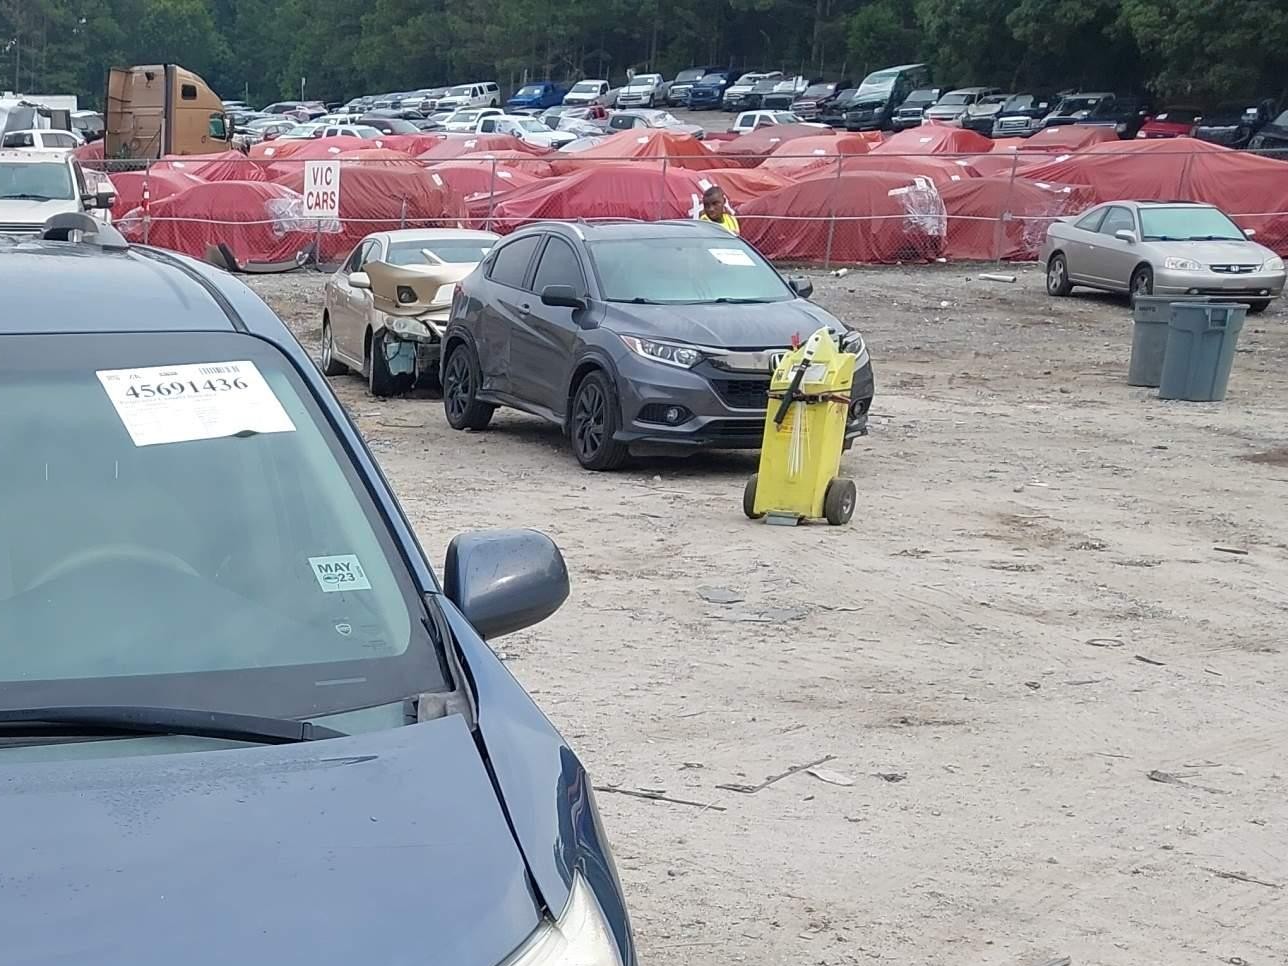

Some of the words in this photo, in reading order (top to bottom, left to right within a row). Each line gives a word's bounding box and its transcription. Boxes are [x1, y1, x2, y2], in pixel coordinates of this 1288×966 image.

[312, 167, 333, 186] VIC
[306, 191, 336, 210] CARS
[125, 376, 249, 399] 45691436
[317, 562, 351, 573] MAY
[337, 573, 356, 582] 23
